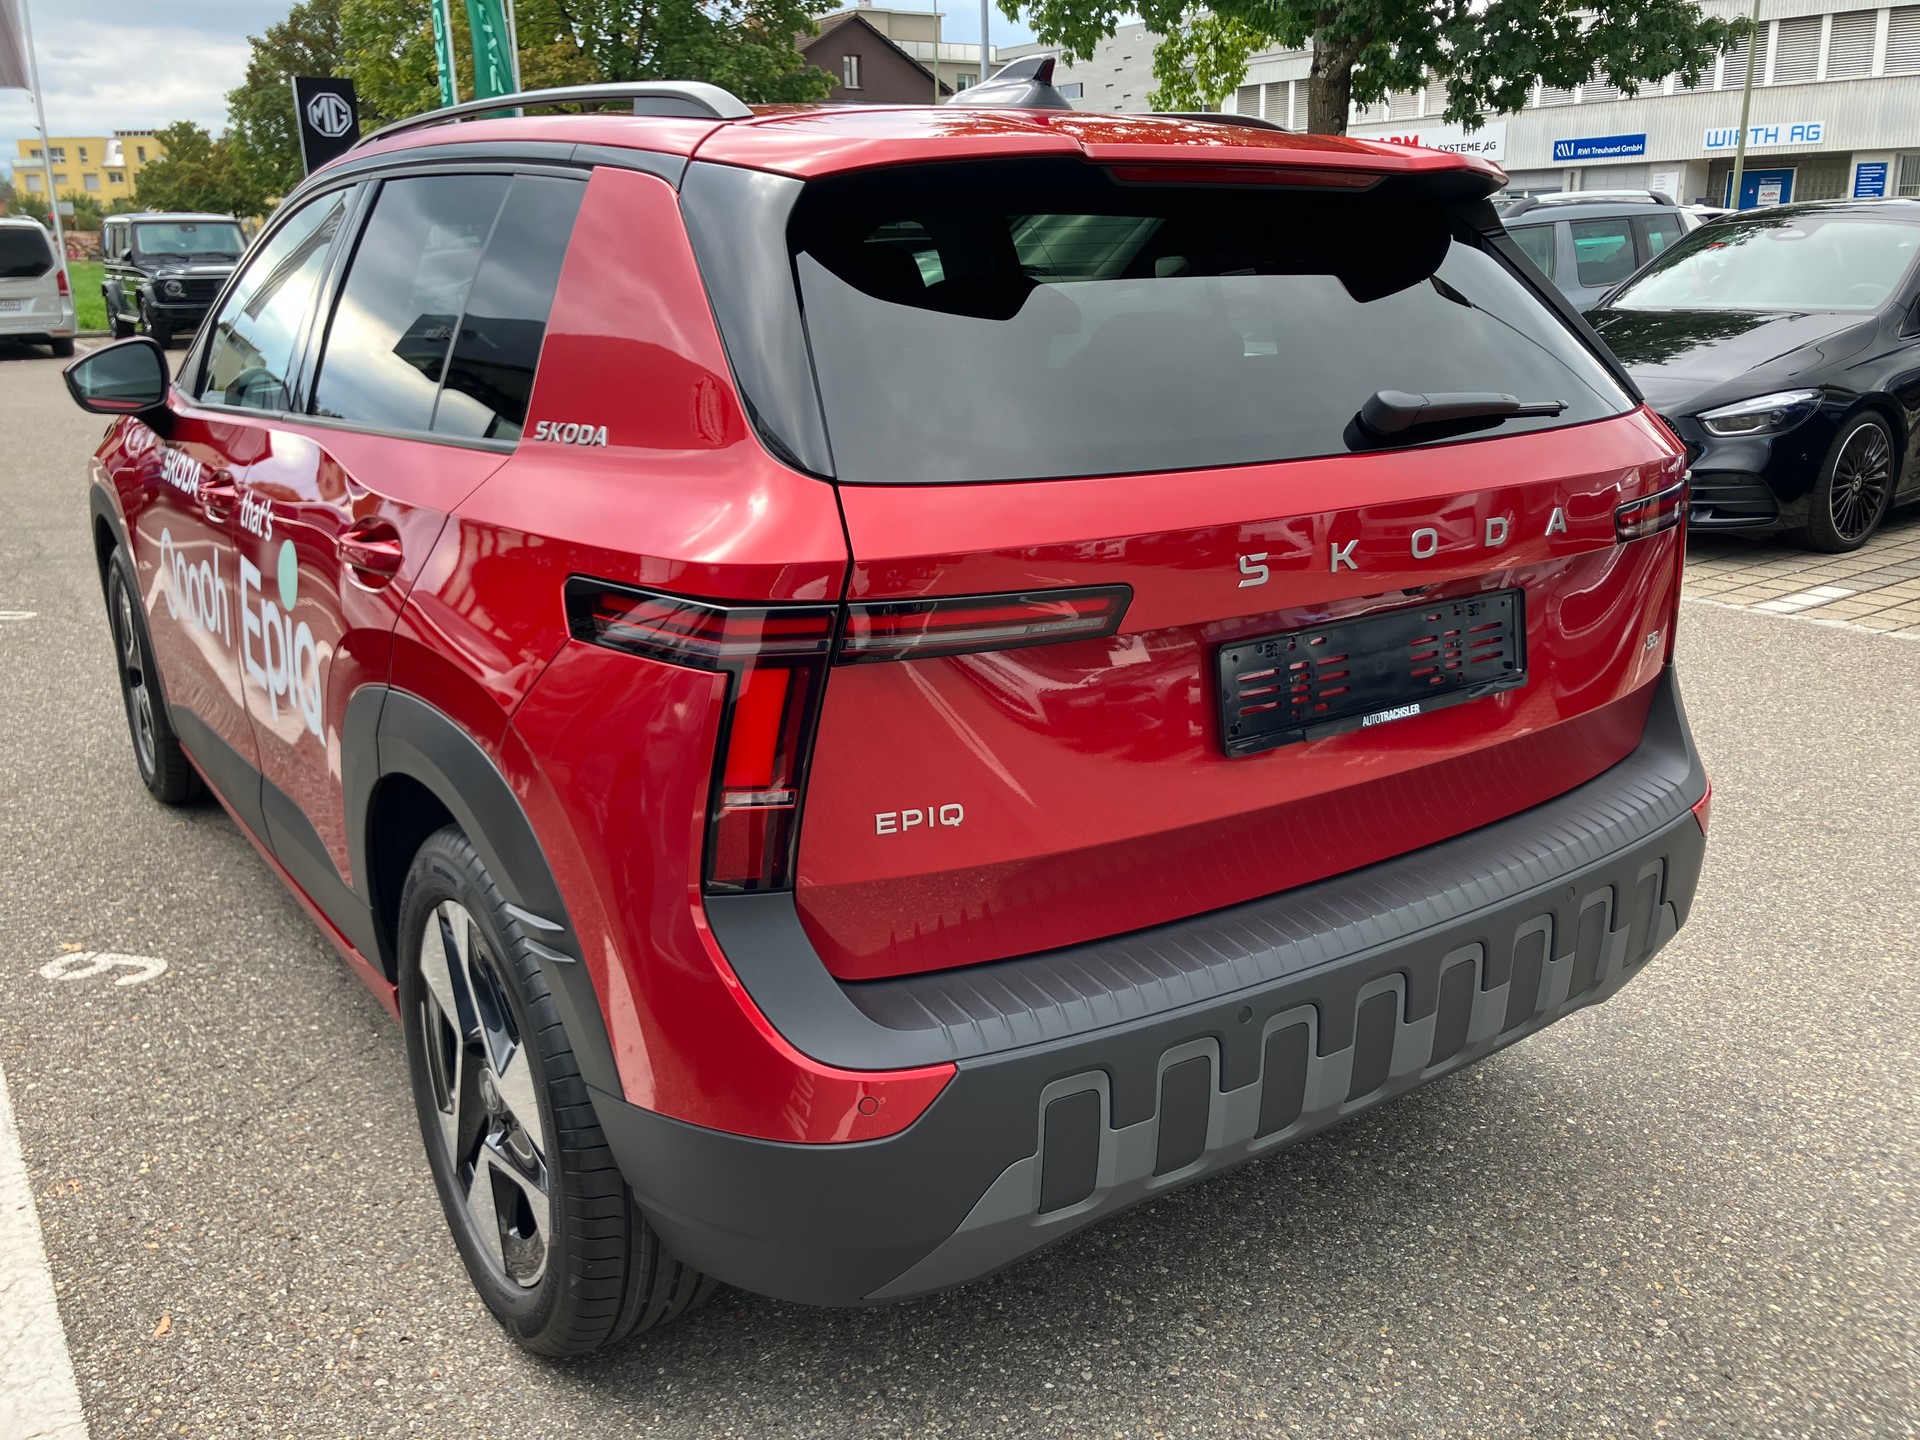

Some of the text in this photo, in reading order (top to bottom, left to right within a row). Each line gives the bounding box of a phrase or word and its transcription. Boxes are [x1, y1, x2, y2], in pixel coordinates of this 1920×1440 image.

[311, 96, 348, 133] MG
[1790, 124, 1821, 142] AG
[1437, 143, 1481, 153] SYSTEME
[1482, 141, 1497, 153] AG
[1577, 144, 1643, 155] RWI Treuhand GmbH
[534, 420, 608, 447] SKODA
[161, 448, 202, 497] SKODA
[240, 490, 274, 542] that's
[1362, 703, 1420, 727] AUTOTRACHSLER
[875, 803, 964, 835] EPIQ
